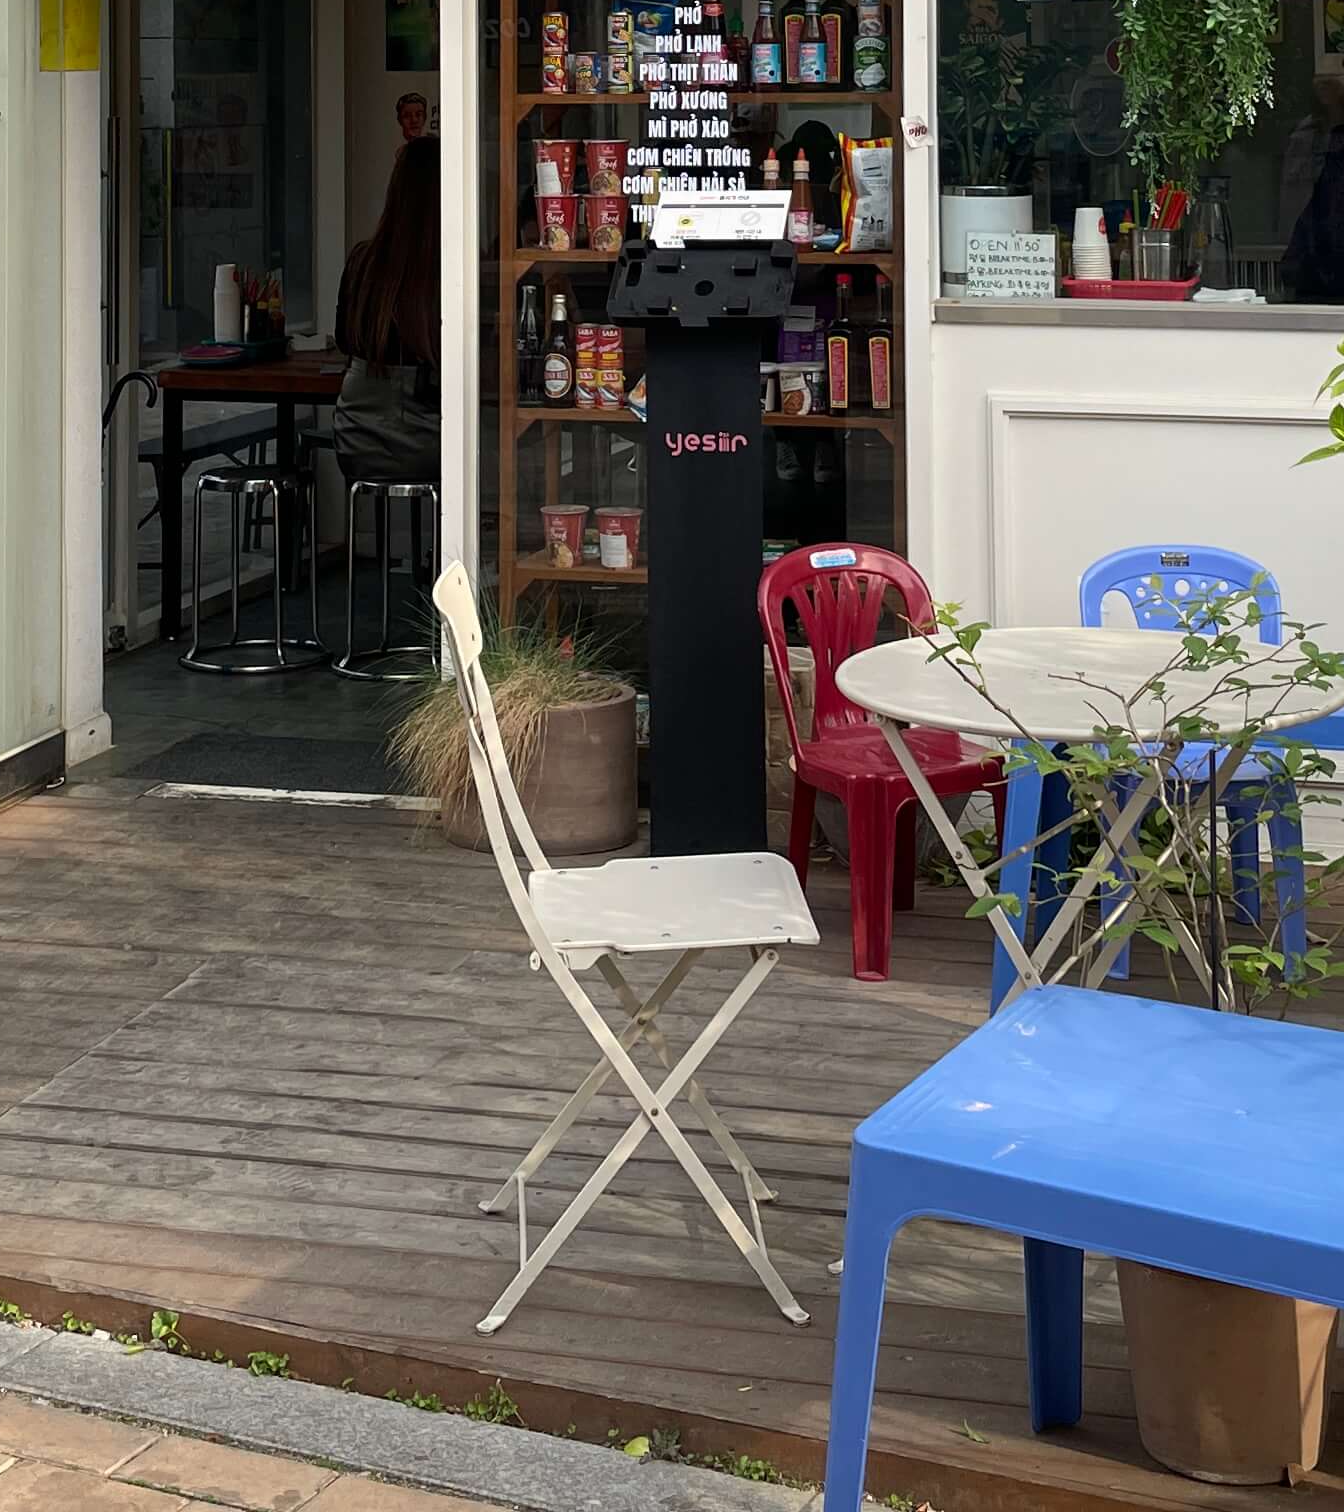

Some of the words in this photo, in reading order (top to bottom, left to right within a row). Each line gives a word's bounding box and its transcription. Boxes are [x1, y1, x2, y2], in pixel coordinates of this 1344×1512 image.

[673, 0, 703, 25] PHỞ
[655, 28, 684, 53] PHỞ
[639, 56, 667, 82] PHỞ
[650, 85, 677, 110] PHỞ
[670, 114, 698, 138] PHỞ
[627, 146, 659, 167] CƠM
[662, 144, 702, 167] CHIÊN
[622, 174, 654, 195] CƠM
